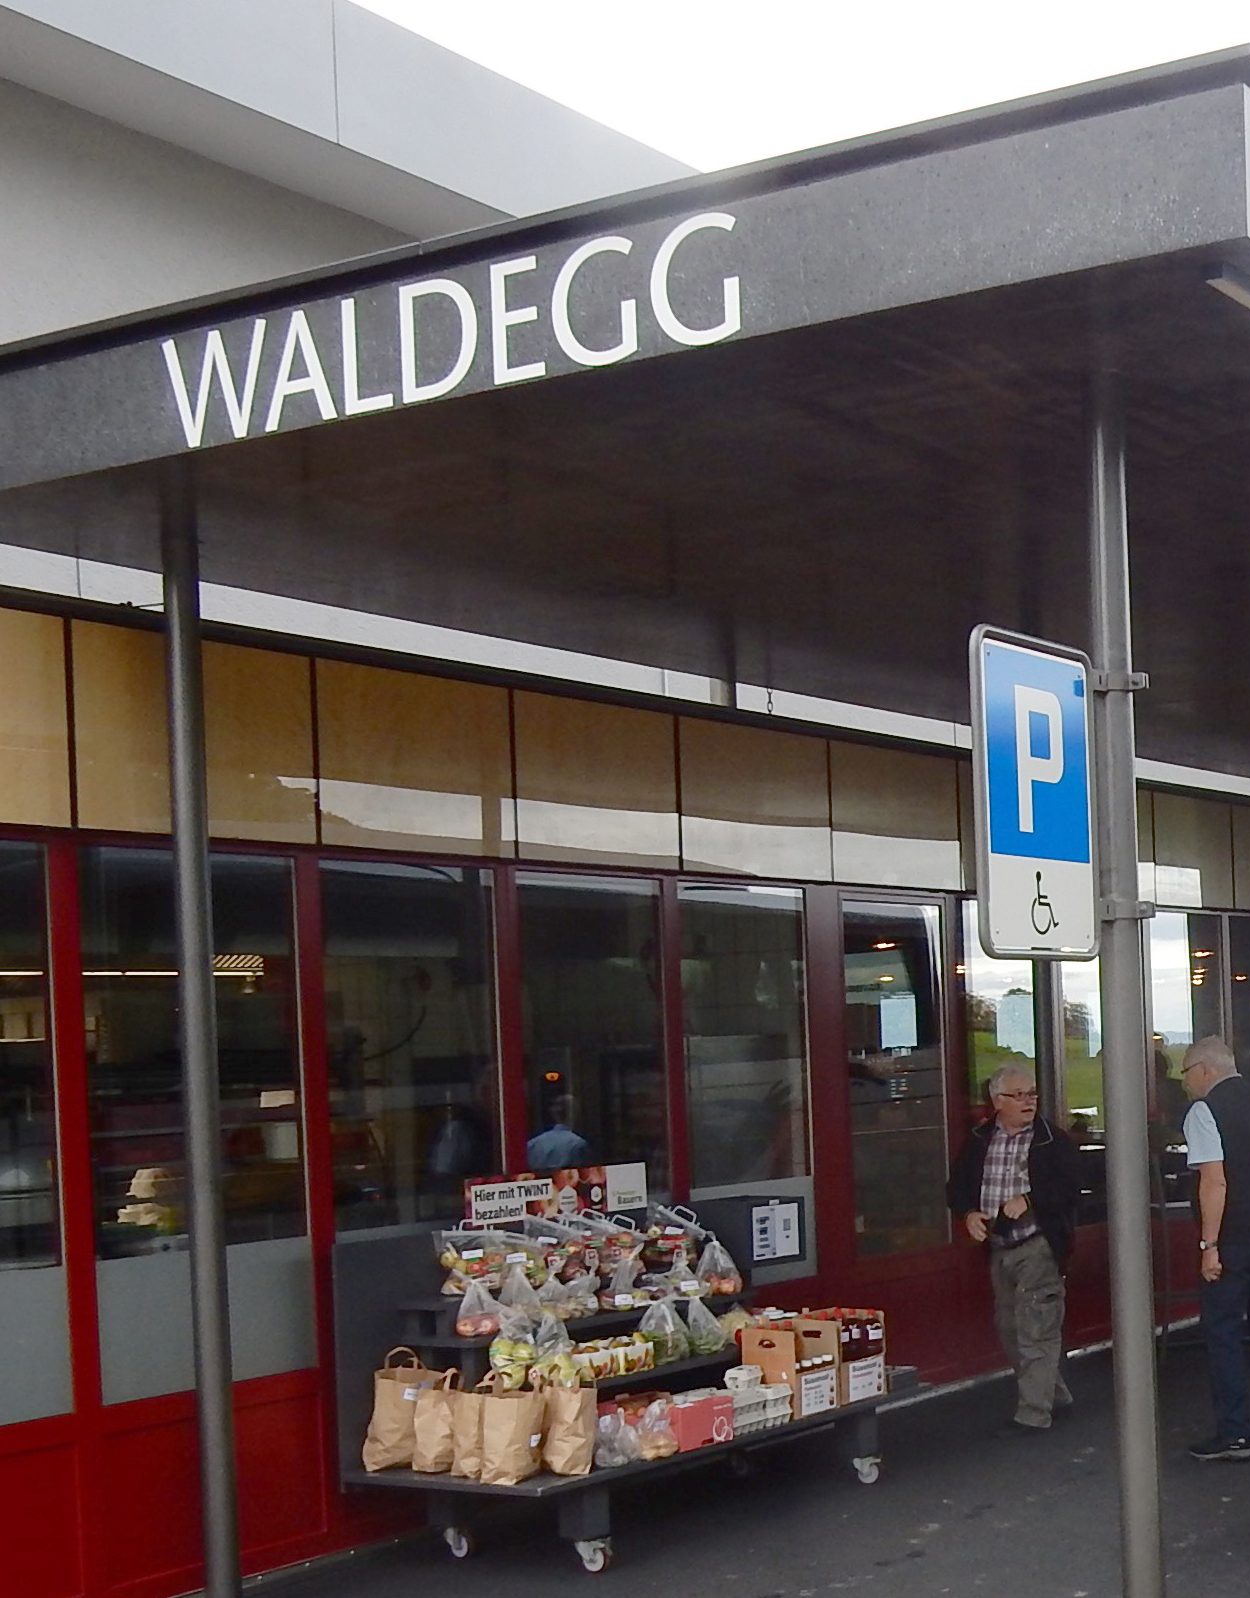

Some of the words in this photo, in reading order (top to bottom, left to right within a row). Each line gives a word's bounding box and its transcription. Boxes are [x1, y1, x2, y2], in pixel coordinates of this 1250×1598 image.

[161, 211, 741, 449] WALDEGG
[1014, 684, 1064, 833] P
[474, 1188, 496, 1203] Hier
[498, 1186, 515, 1200] mit
[516, 1182, 550, 1198] TWINT
[475, 1204, 524, 1221] bezahlen!
